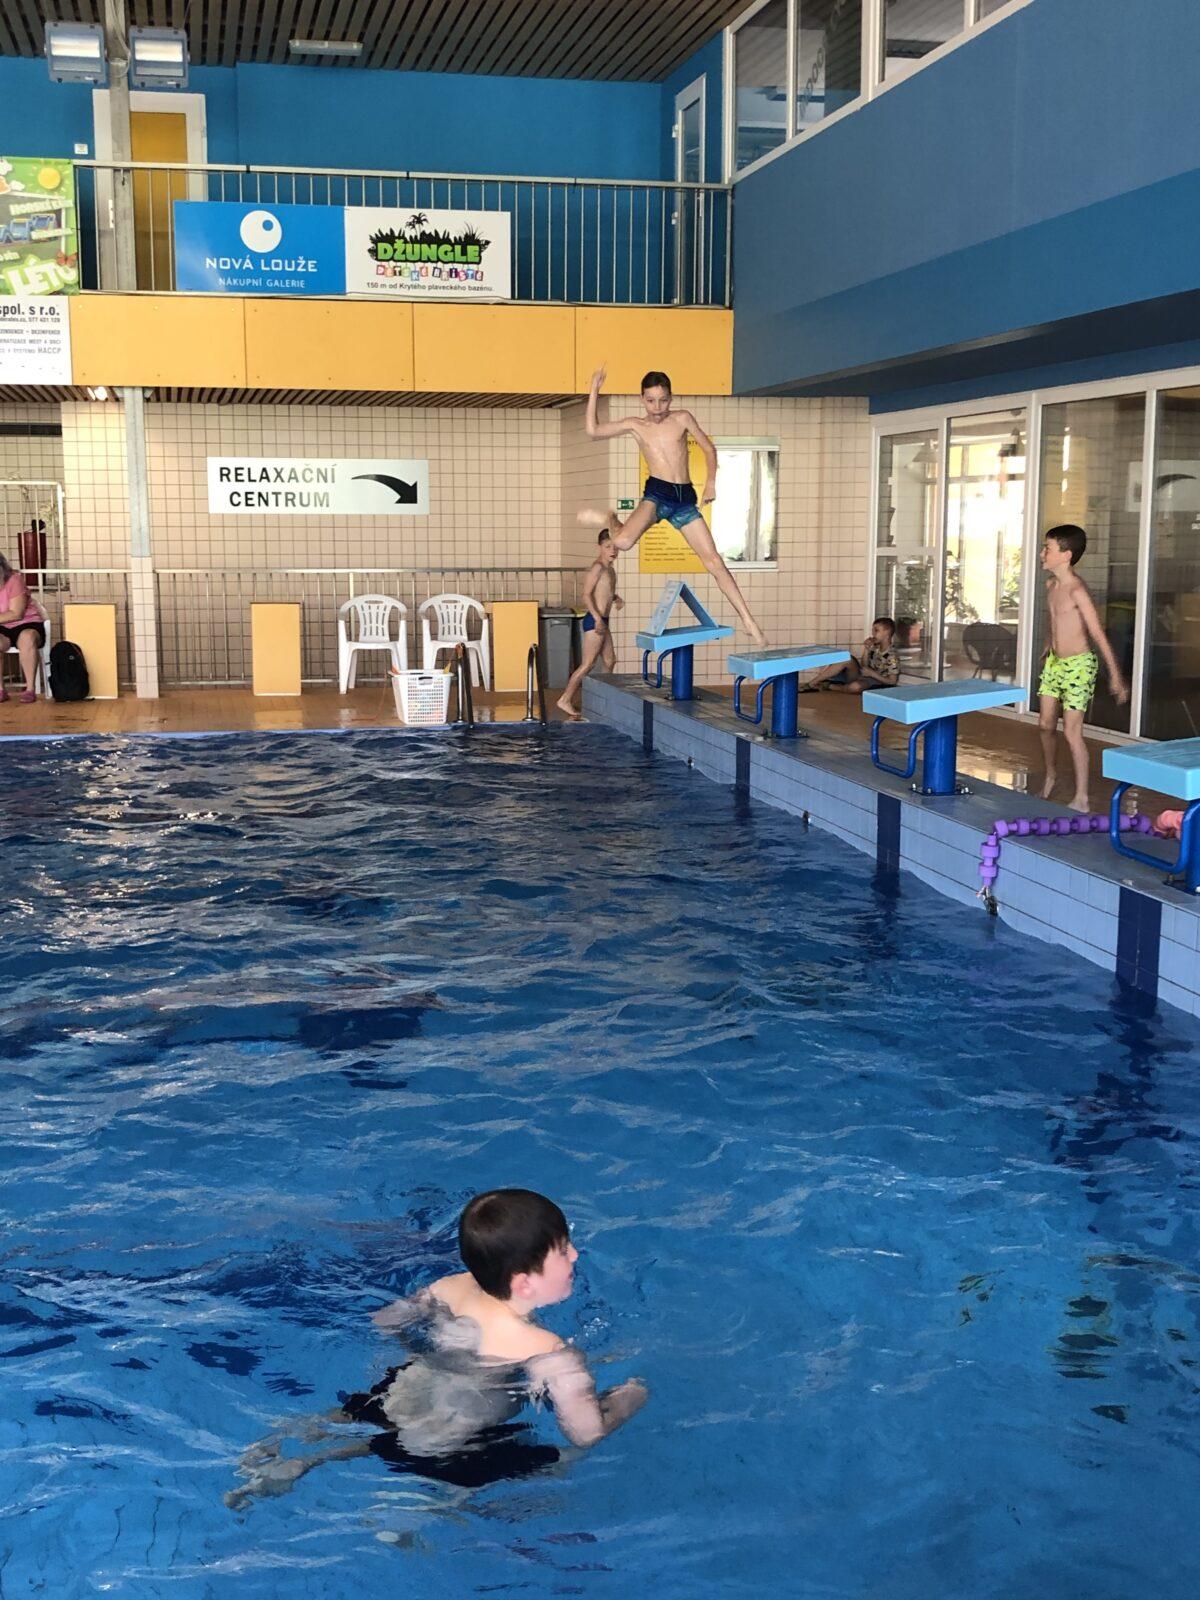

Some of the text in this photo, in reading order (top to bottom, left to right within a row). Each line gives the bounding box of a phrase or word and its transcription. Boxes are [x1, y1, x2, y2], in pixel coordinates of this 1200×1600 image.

[376, 239, 481, 263] DŽUNGLE
[205, 255, 318, 272] NOVÁ LOUŽE
[218, 277, 306, 288] NÁKUPNÍ GALERIE
[400, 282, 426, 291] Krytého
[427, 283, 466, 292] plaveckého
[29, 306, 36, 316] s
[39, 306, 60, 316] r.o.
[219, 463, 337, 483] RELAXAČNÍ
[229, 491, 330, 507] CENTRUM
